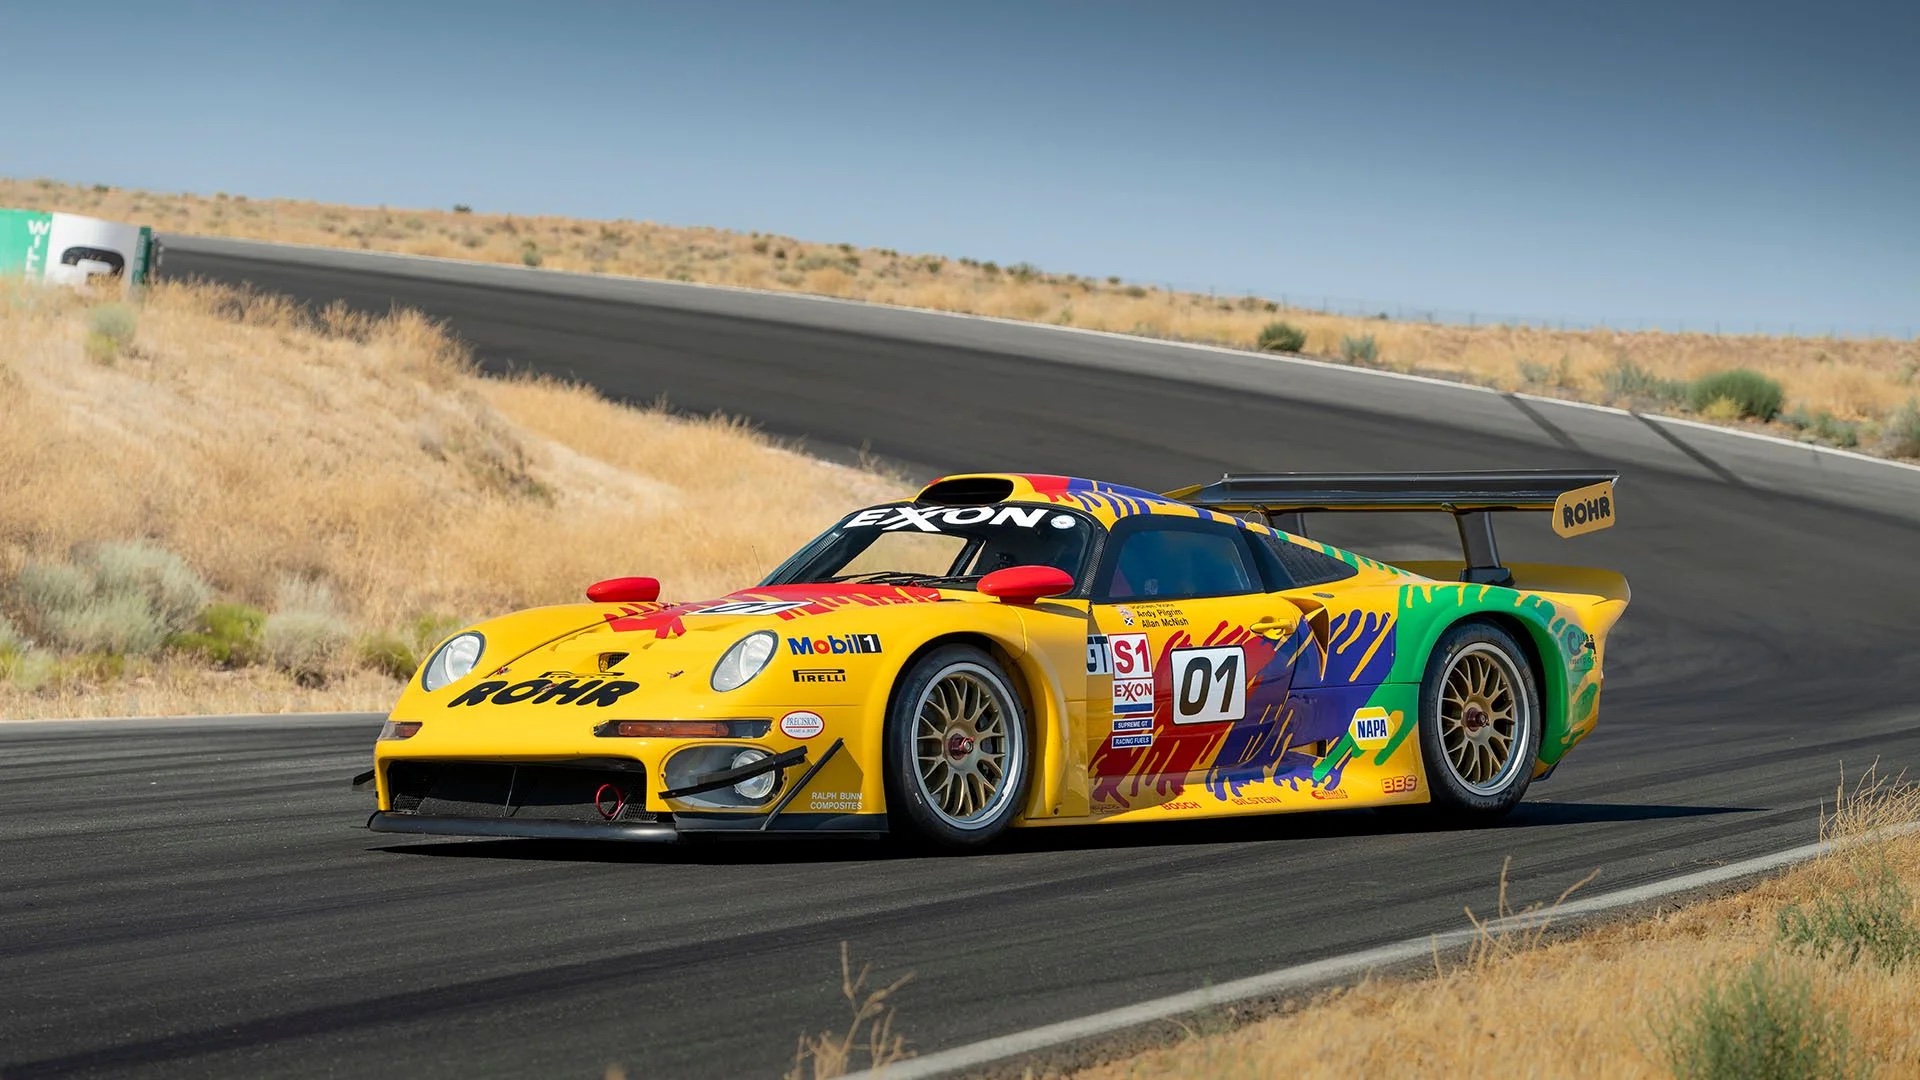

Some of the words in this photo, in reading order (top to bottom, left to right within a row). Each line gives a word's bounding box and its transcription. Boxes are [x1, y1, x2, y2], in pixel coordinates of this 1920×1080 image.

[843, 506, 1049, 532] EXXON
[1137, 610, 1157, 619] Andy
[1157, 608, 1184, 618] Pilgrim
[1142, 619, 1161, 628] Allan
[1161, 617, 1189, 627] McNish
[1114, 639, 1150, 674] S1
[793, 669, 846, 682] PIRELLI
[1179, 655, 1239, 716] 01
[1114, 682, 1153, 703] EXXON
[786, 717, 819, 726] PRECISION
[1118, 721, 1141, 729] SUPREME
[1141, 719, 1149, 728] GT
[1357, 719, 1388, 738] NAPA
[1115, 737, 1133, 745] RACING
[1134, 736, 1150, 744] FUELS
[1381, 775, 1418, 794] BBS
[811, 791, 837, 800] RALPH
[840, 791, 863, 800] BUNN
[1231, 796, 1282, 806] BILSTEIN
[810, 801, 863, 810] COMPOSITES
[1160, 801, 1202, 811] BOSCH
